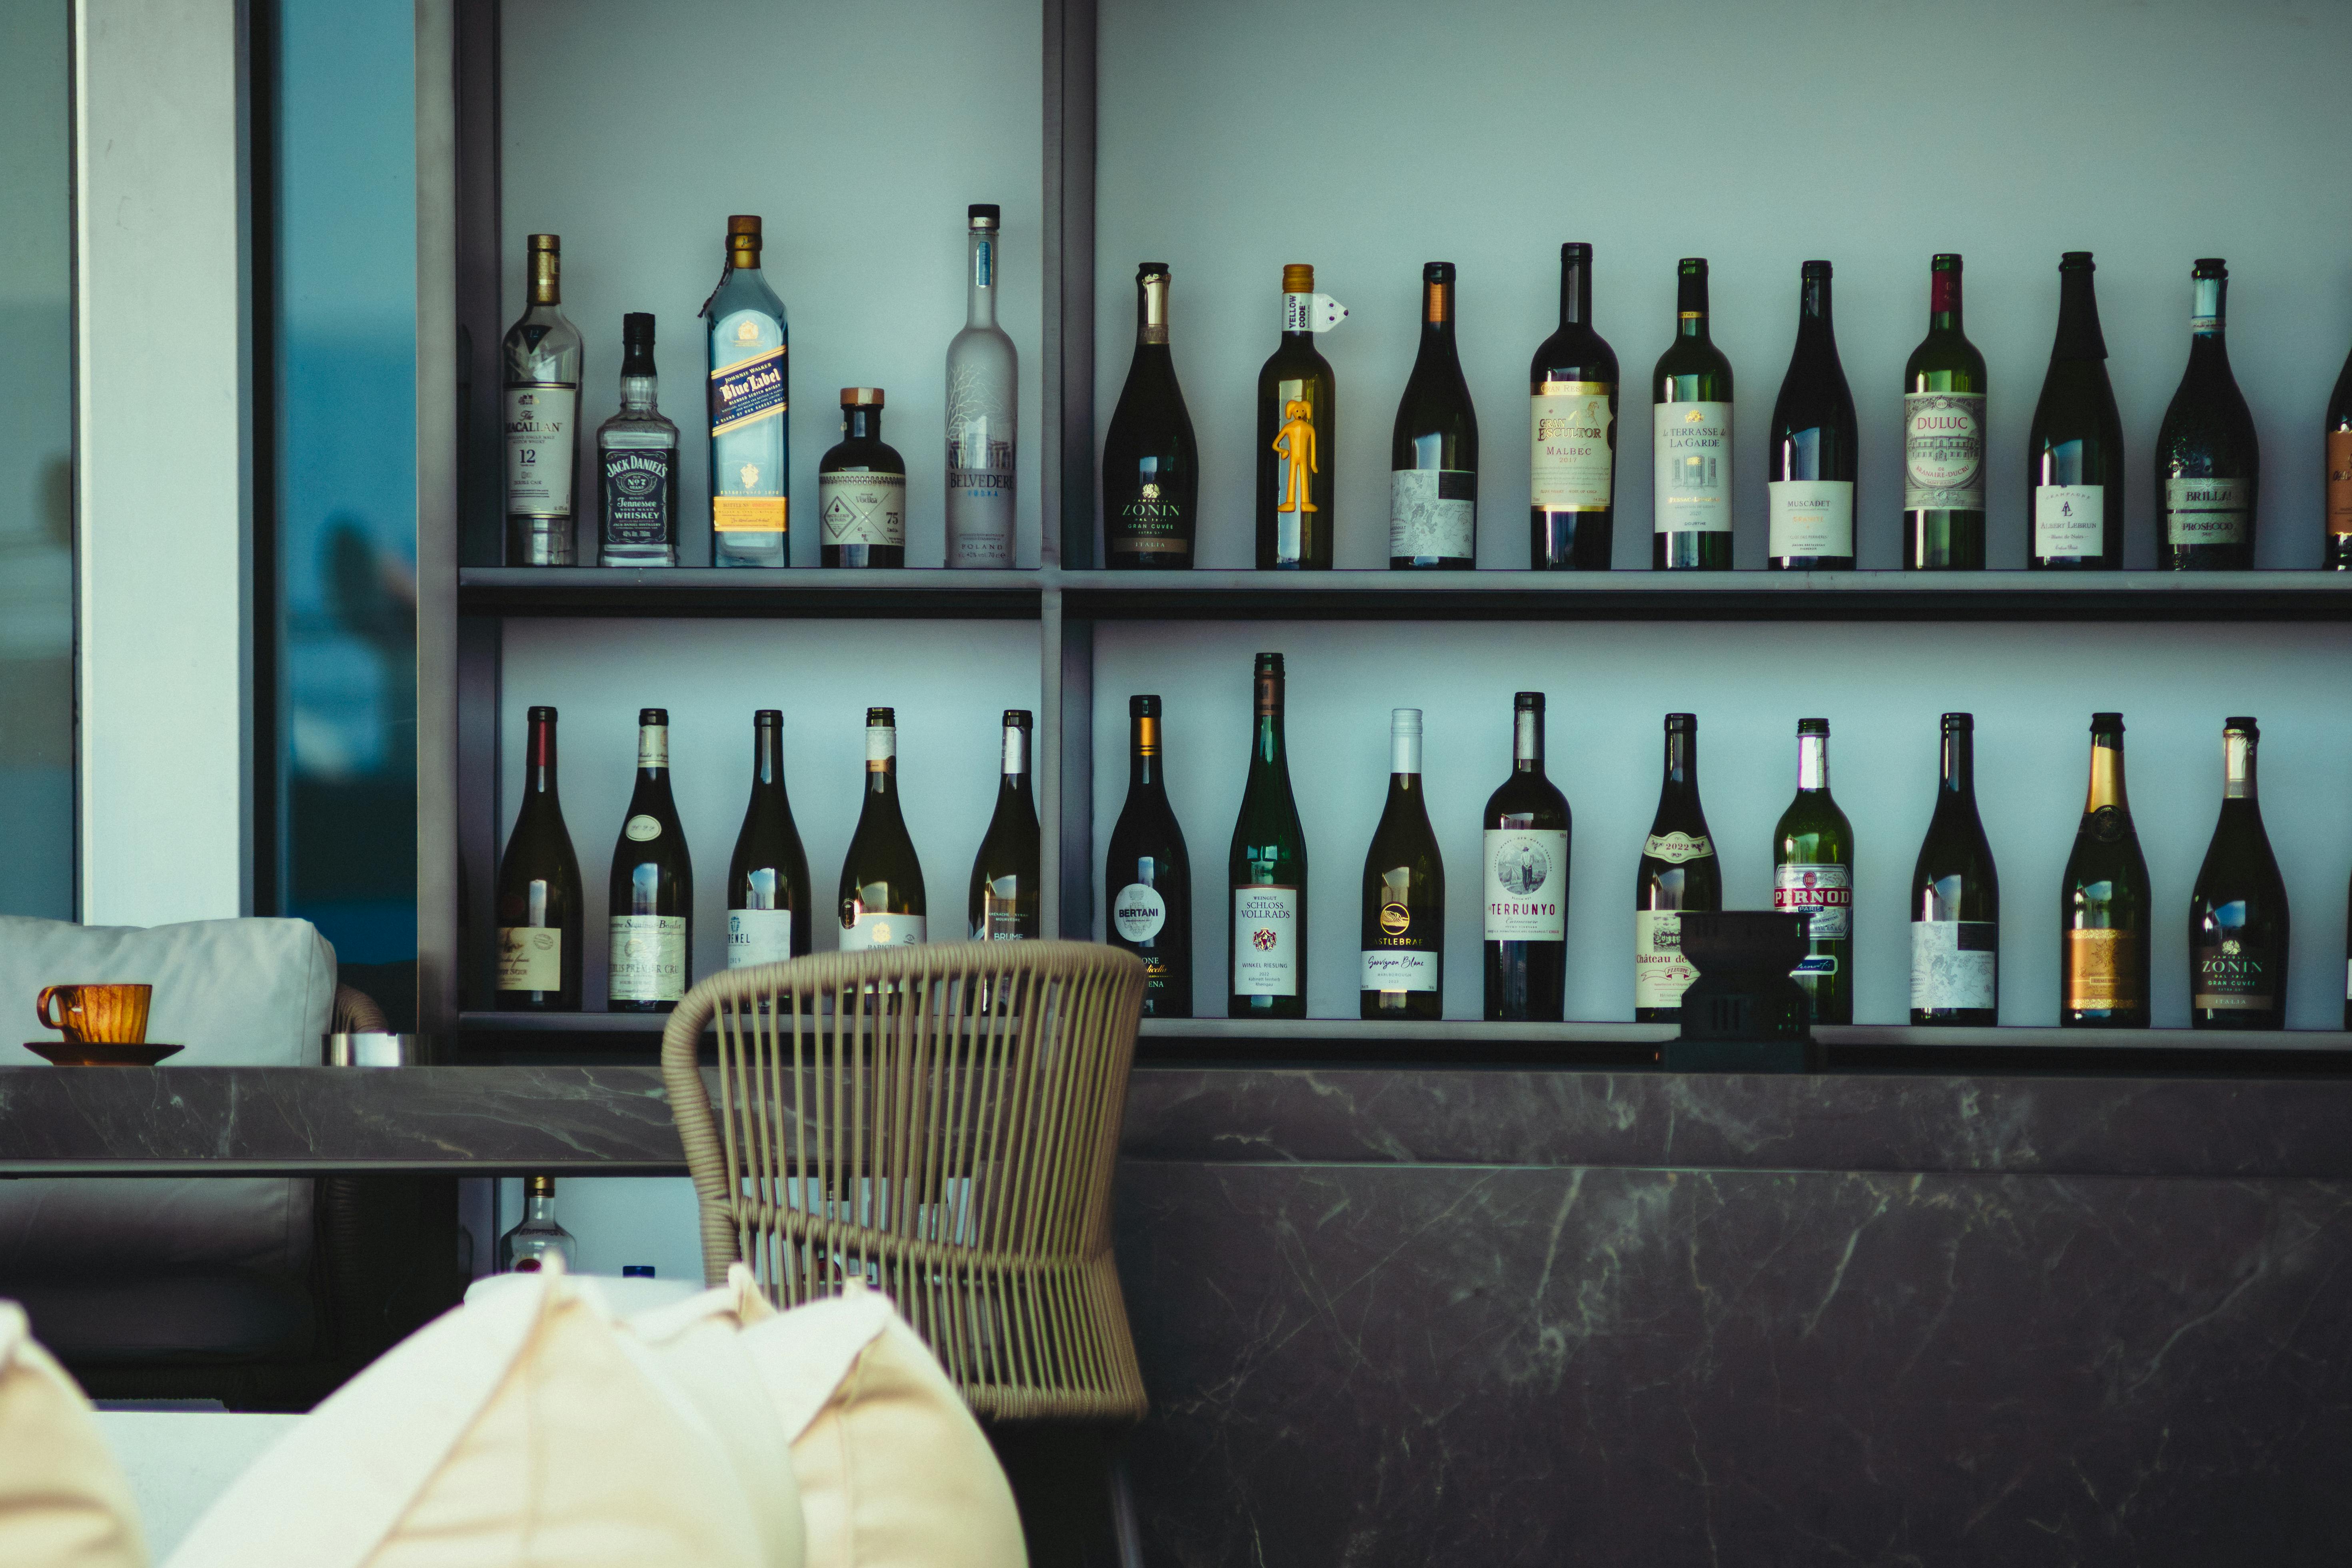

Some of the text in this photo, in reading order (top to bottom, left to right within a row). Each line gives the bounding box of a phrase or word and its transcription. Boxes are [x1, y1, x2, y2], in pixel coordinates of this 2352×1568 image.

[725, 362, 772, 384] JOHNNIE WALKER
[719, 382, 749, 402] Blue
[747, 368, 781, 392] Label
[1539, 419, 1566, 427] GRAN
[1917, 417, 1968, 429] DULUC
[1537, 428, 1601, 441] ESCULTOR
[1670, 428, 1718, 436] TERRASSE
[1670, 438, 1720, 447] LA GARDE
[520, 449, 536, 463] 12
[1547, 447, 1591, 455] MALBEC
[607, 455, 668, 477] JACK DANIEL'S
[1916, 465, 1970, 477] BRANAIRE-DUCRU
[950, 473, 1013, 490] BELVEDERE
[617, 497, 657, 507] Tennessee
[1123, 505, 1179, 516] ZONIN
[886, 512, 899, 525] 75
[2182, 523, 2233, 531] PROSECCO
[1775, 890, 1850, 904] PERNOD
[1119, 908, 1158, 918] BERTANI
[1241, 910, 1290, 919] VOLLRADS
[1492, 903, 1555, 915] TERRUNYO
[1368, 956, 1424, 969] Sauvignon Blanc
[1637, 954, 1671, 963] Château
[665, 965, 679, 973] CRU
[2202, 961, 2262, 973] ZONIN
